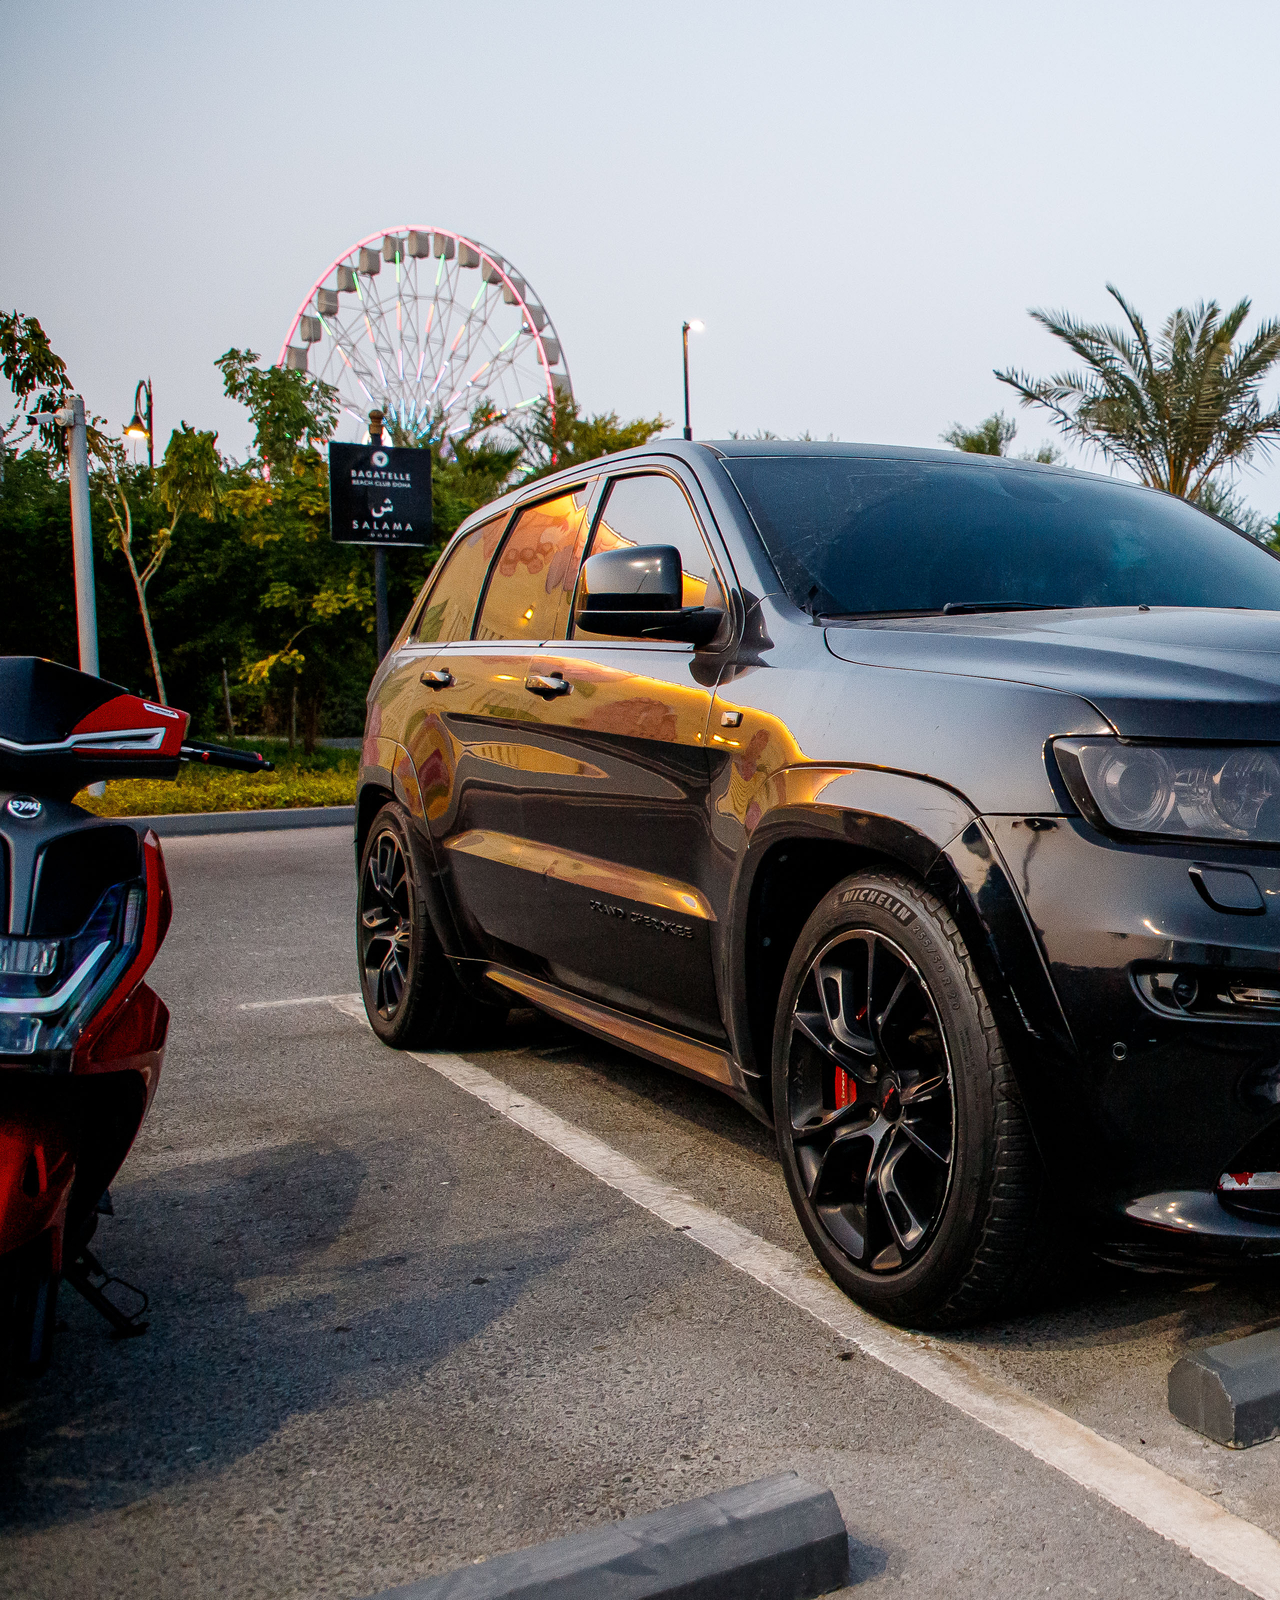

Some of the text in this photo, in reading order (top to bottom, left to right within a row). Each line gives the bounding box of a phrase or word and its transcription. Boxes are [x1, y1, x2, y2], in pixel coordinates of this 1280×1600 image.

[351, 470, 410, 481] BAGATELLE
[352, 520, 413, 531] SALAMA
[11, 800, 39, 811] SYM
[842, 889, 912, 922] MICHELIN
[912, 924, 946, 973] 255/50
[941, 976, 953, 987] R
